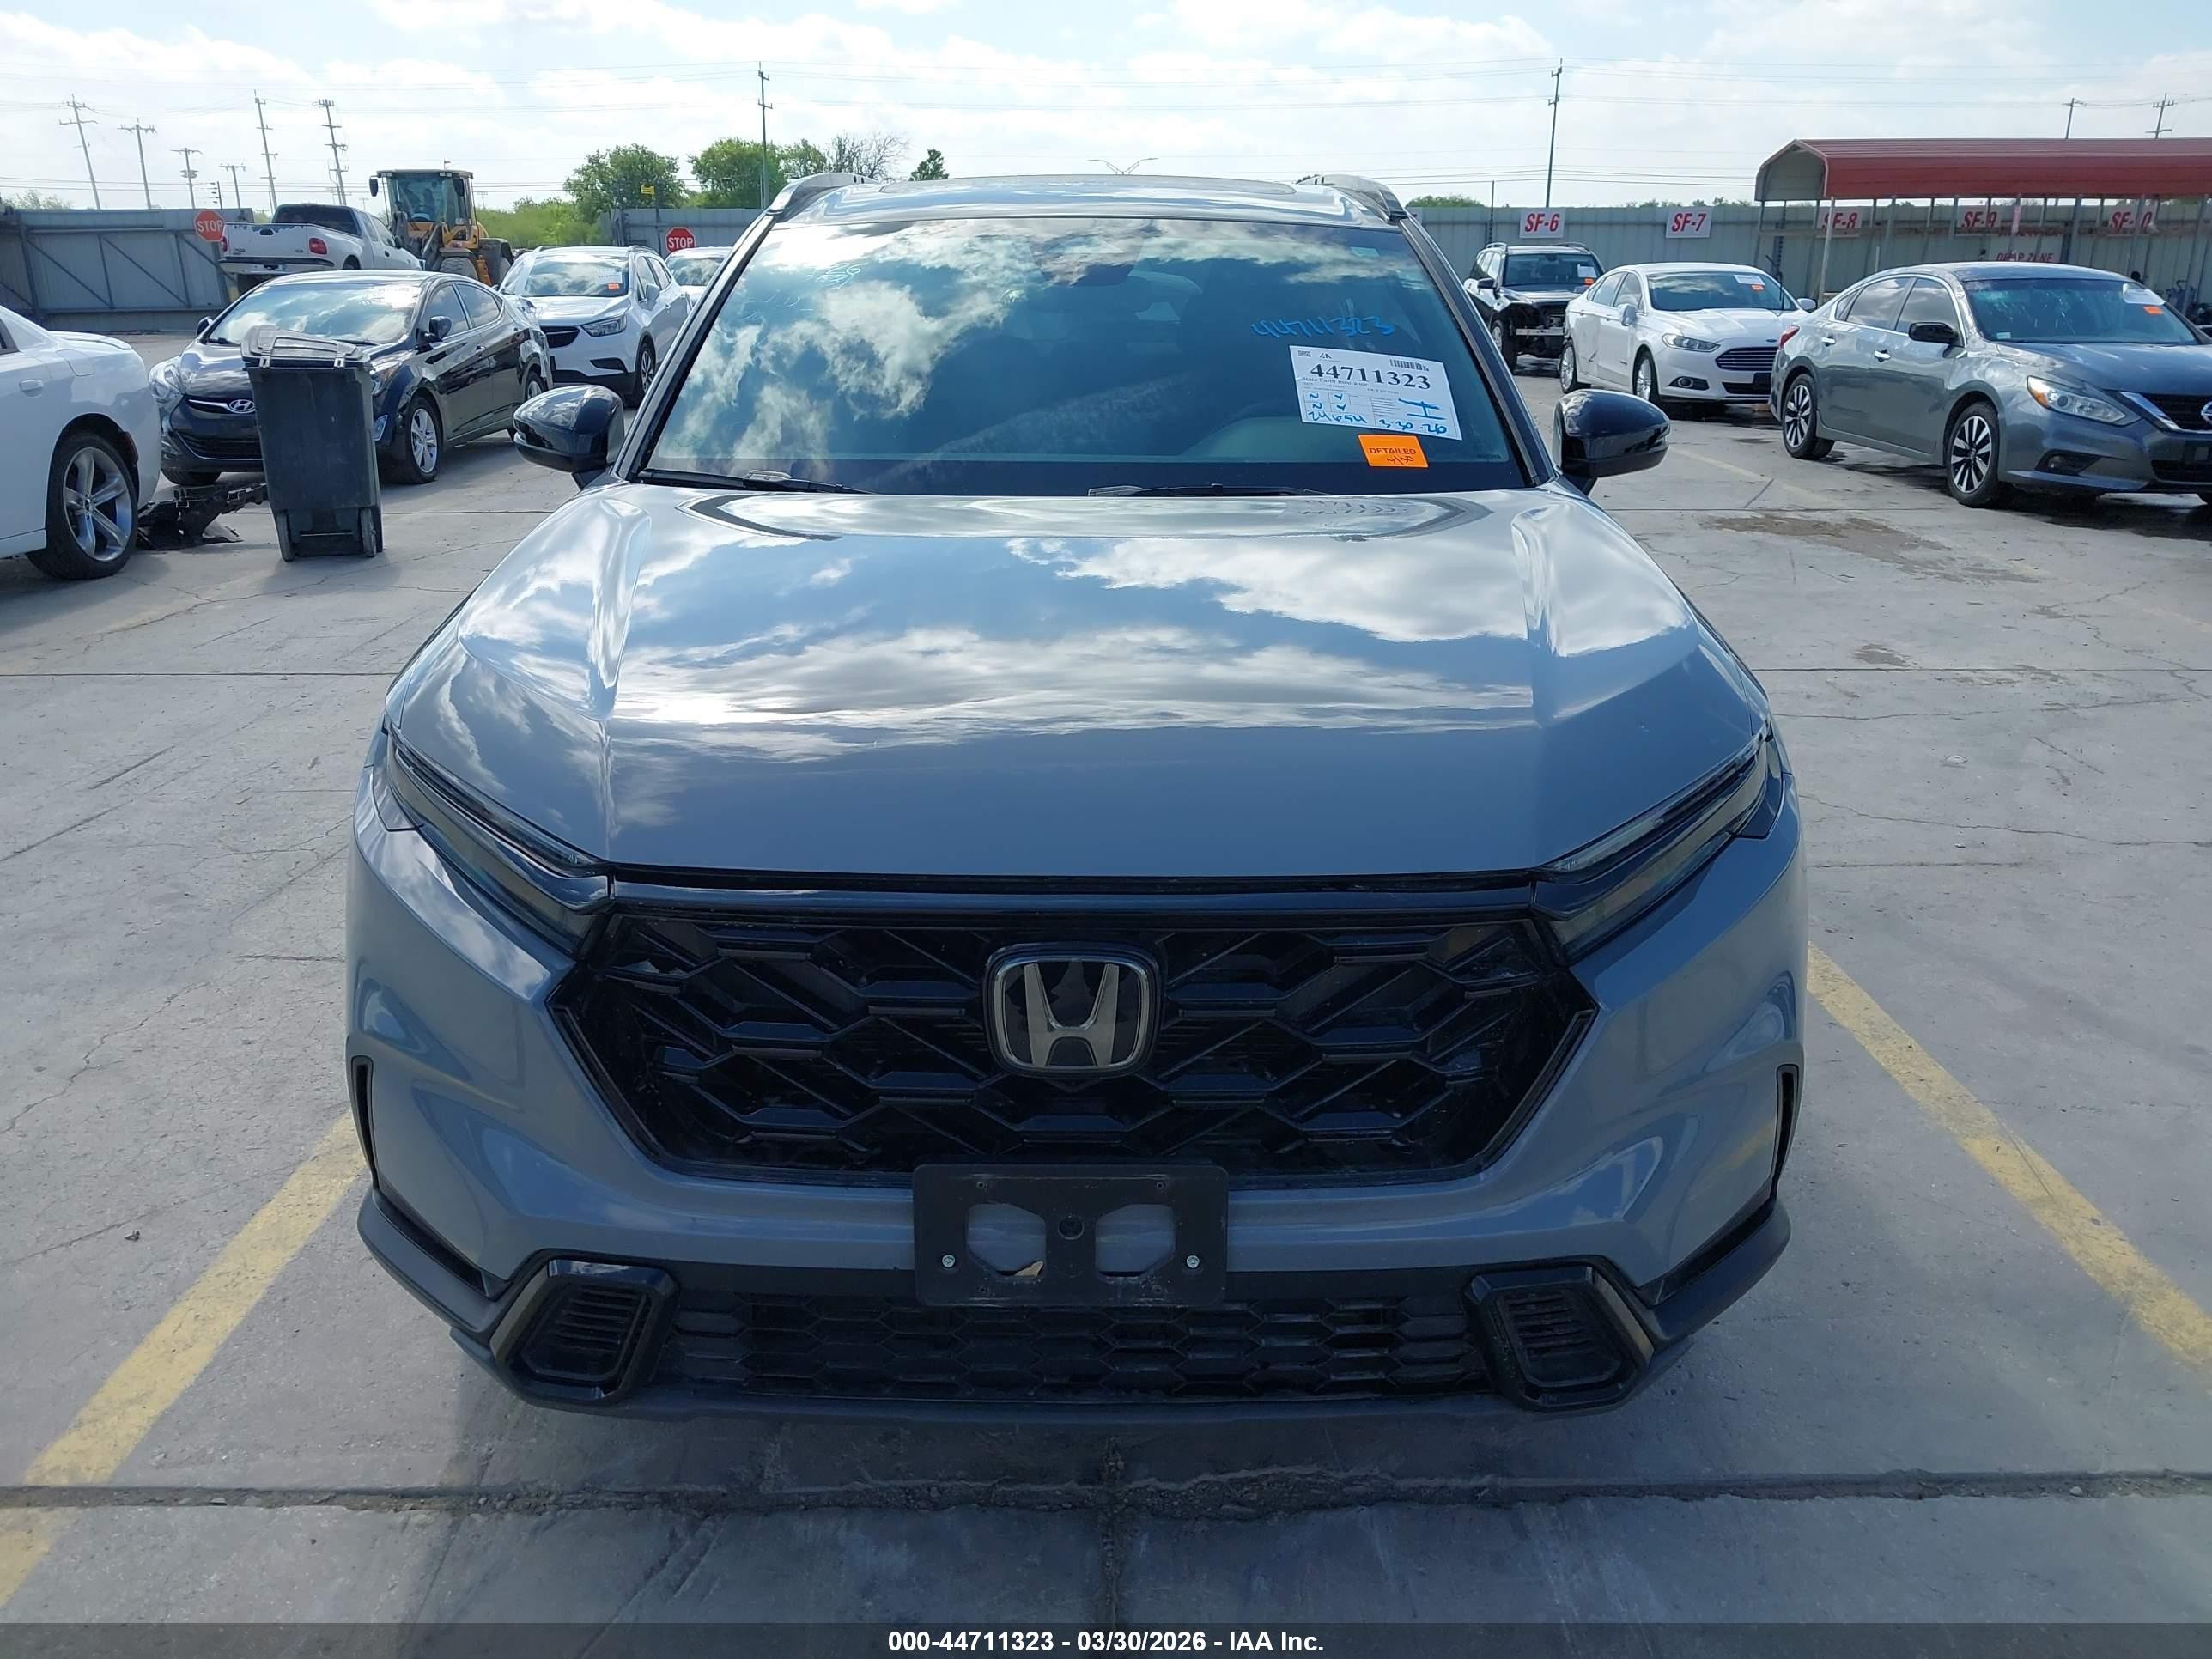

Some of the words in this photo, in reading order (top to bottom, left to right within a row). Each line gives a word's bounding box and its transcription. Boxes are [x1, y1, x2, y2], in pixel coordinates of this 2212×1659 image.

[198, 220, 223, 233] STOP
[1524, 213, 1560, 232] SF-6
[1672, 212, 1707, 232] SF-7
[668, 236, 694, 249] STOP
[1310, 363, 1431, 390] 44711323
